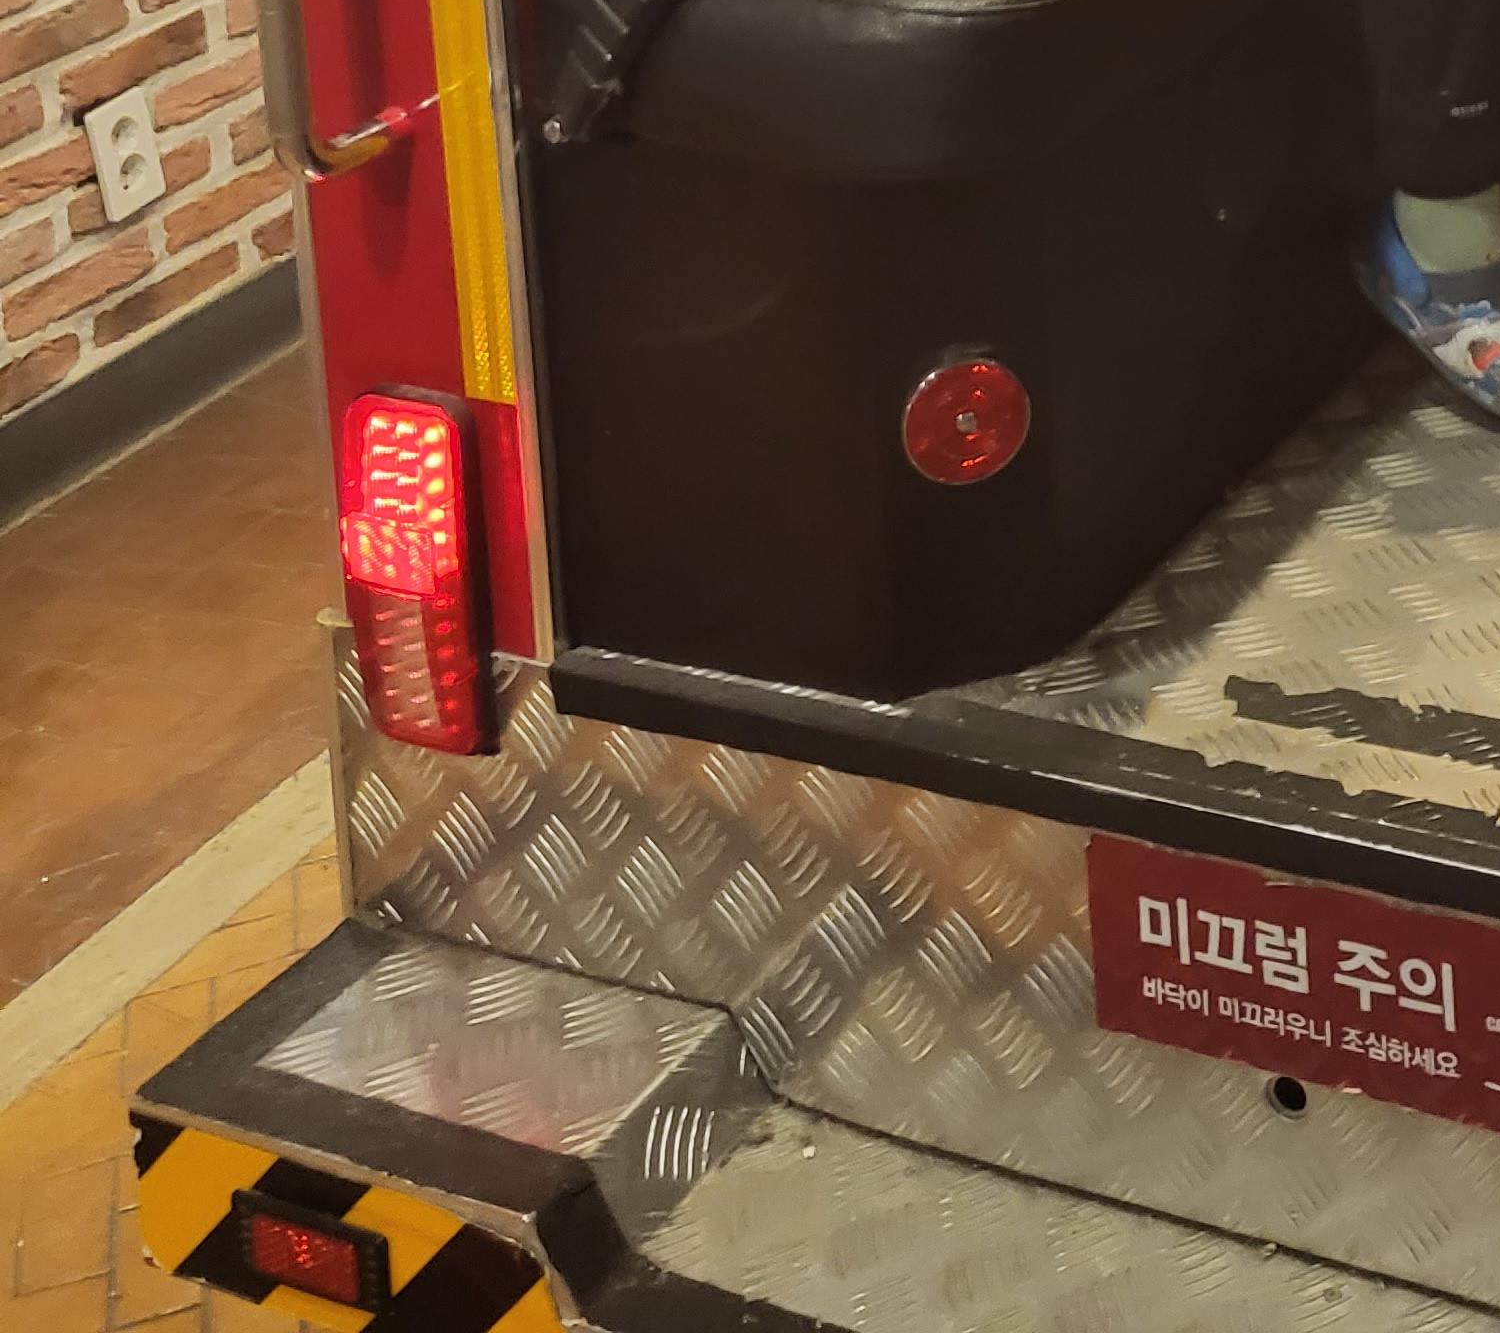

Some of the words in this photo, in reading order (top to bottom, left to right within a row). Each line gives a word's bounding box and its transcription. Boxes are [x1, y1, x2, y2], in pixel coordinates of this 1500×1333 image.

[1138, 895, 1310, 994] 미끄럼
[1333, 938, 1456, 1032] 주의
[1142, 975, 1209, 1017] 바닥이
[1218, 995, 1332, 1047] 미끄러우니
[1341, 1026, 1462, 1078] 조심하세요
